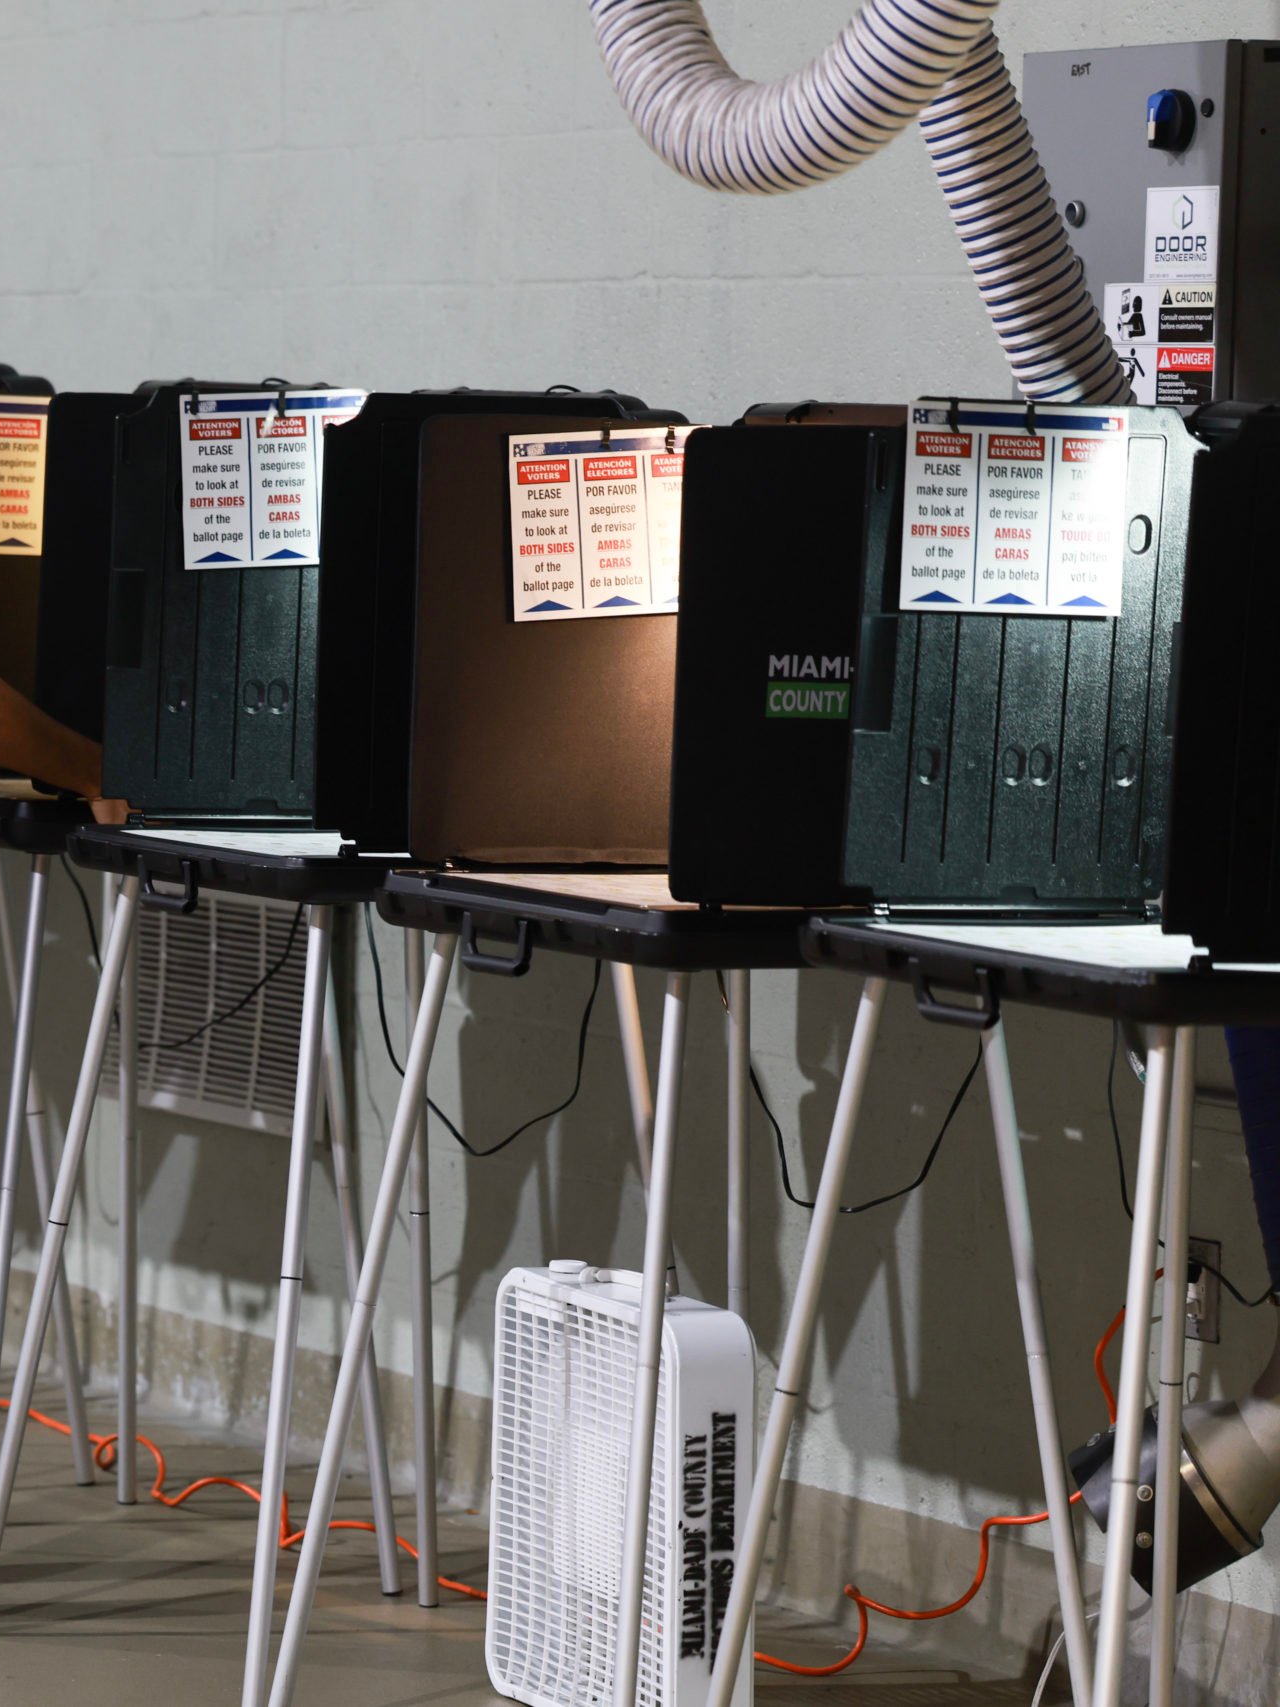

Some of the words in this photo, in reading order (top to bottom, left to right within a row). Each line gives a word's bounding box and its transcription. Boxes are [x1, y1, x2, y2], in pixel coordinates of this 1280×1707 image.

[1155, 236, 1207, 252] DOOR
[1155, 253, 1207, 262] ENGINEERING
[1175, 292, 1212, 302] CAUTION
[1172, 353, 1210, 365] DANGER
[192, 422, 239, 430] ATTENTION
[918, 435, 969, 445] ATTENTION
[993, 438, 1040, 447] ATENCIÓN
[13, 443, 38, 452] FAVOR
[199, 445, 233, 456] PLEASE
[258, 444, 275, 453] POR
[278, 443, 306, 453] FAVOR
[926, 445, 961, 454] VOTERS
[991, 448, 1042, 458] ELECTORES
[193, 464, 218, 473] make
[221, 463, 240, 472] sure
[260, 461, 305, 472] asegúrese
[520, 464, 566, 472] ATTENTION
[588, 460, 631, 469] ATENCIÓN
[924, 463, 961, 476] PLEASE
[527, 472, 560, 480] VOTERS
[587, 469, 634, 477] ELECTORES
[988, 466, 1008, 478] POR
[1011, 467, 1043, 479] FAVOR
[195, 481, 204, 490] to
[207, 480, 226, 490] look
[229, 480, 238, 489] at
[262, 478, 272, 487] de
[275, 477, 305, 487] revisar
[0, 489, 30, 498] AMBAS
[528, 488, 562, 500] PLEASE
[586, 486, 605, 496] POR
[608, 485, 637, 495] FAVOR
[917, 484, 943, 496] make
[946, 486, 967, 497] sure
[989, 488, 1040, 501] asegúrese
[190, 497, 214, 508] BOTH
[217, 496, 244, 506] SIDES
[267, 494, 301, 504] AMBAS
[0, 505, 28, 514] CARAS
[522, 508, 547, 519] make
[550, 507, 569, 517] sure
[589, 504, 636, 516] asegúrese
[919, 505, 928, 516] to
[931, 505, 951, 516] look
[955, 506, 964, 517] at
[990, 508, 1001, 518] de
[1004, 509, 1038, 520] revisar
[204, 515, 213, 525] of
[216, 515, 230, 524] the
[269, 511, 300, 521] CARAS
[2, 521, 9, 529] la
[12, 521, 37, 530] boleta
[525, 527, 534, 536] to
[537, 525, 556, 536] look
[559, 525, 567, 535] at
[591, 523, 602, 533] de
[605, 523, 636, 532] revisar
[911, 524, 937, 536] BOTH
[941, 525, 970, 537] SIDES
[193, 531, 219, 542] ballot
[221, 532, 243, 543] page
[259, 529, 270, 539] de
[273, 529, 280, 539] la
[284, 528, 311, 538] boleta
[995, 528, 1031, 540] AMBAS
[520, 544, 544, 555] BOTH
[548, 542, 574, 553] SIDES
[597, 539, 632, 550] AMBAS
[926, 546, 935, 557] of
[938, 547, 953, 558] the
[995, 548, 1029, 560] CARAS
[535, 562, 544, 573] of
[547, 562, 561, 572] the
[600, 558, 631, 568] CARAS
[912, 566, 939, 578] ballot
[942, 569, 965, 581] page
[983, 568, 995, 580] de
[998, 568, 1006, 580] la
[1009, 569, 1039, 581] boleta
[523, 580, 549, 591] ballot
[552, 580, 574, 590] page
[590, 577, 600, 587] de
[604, 576, 612, 586] la
[615, 575, 643, 585] boleta
[770, 689, 847, 712] COUNTY
[711, 1412, 736, 1552] DEPARTMENT
